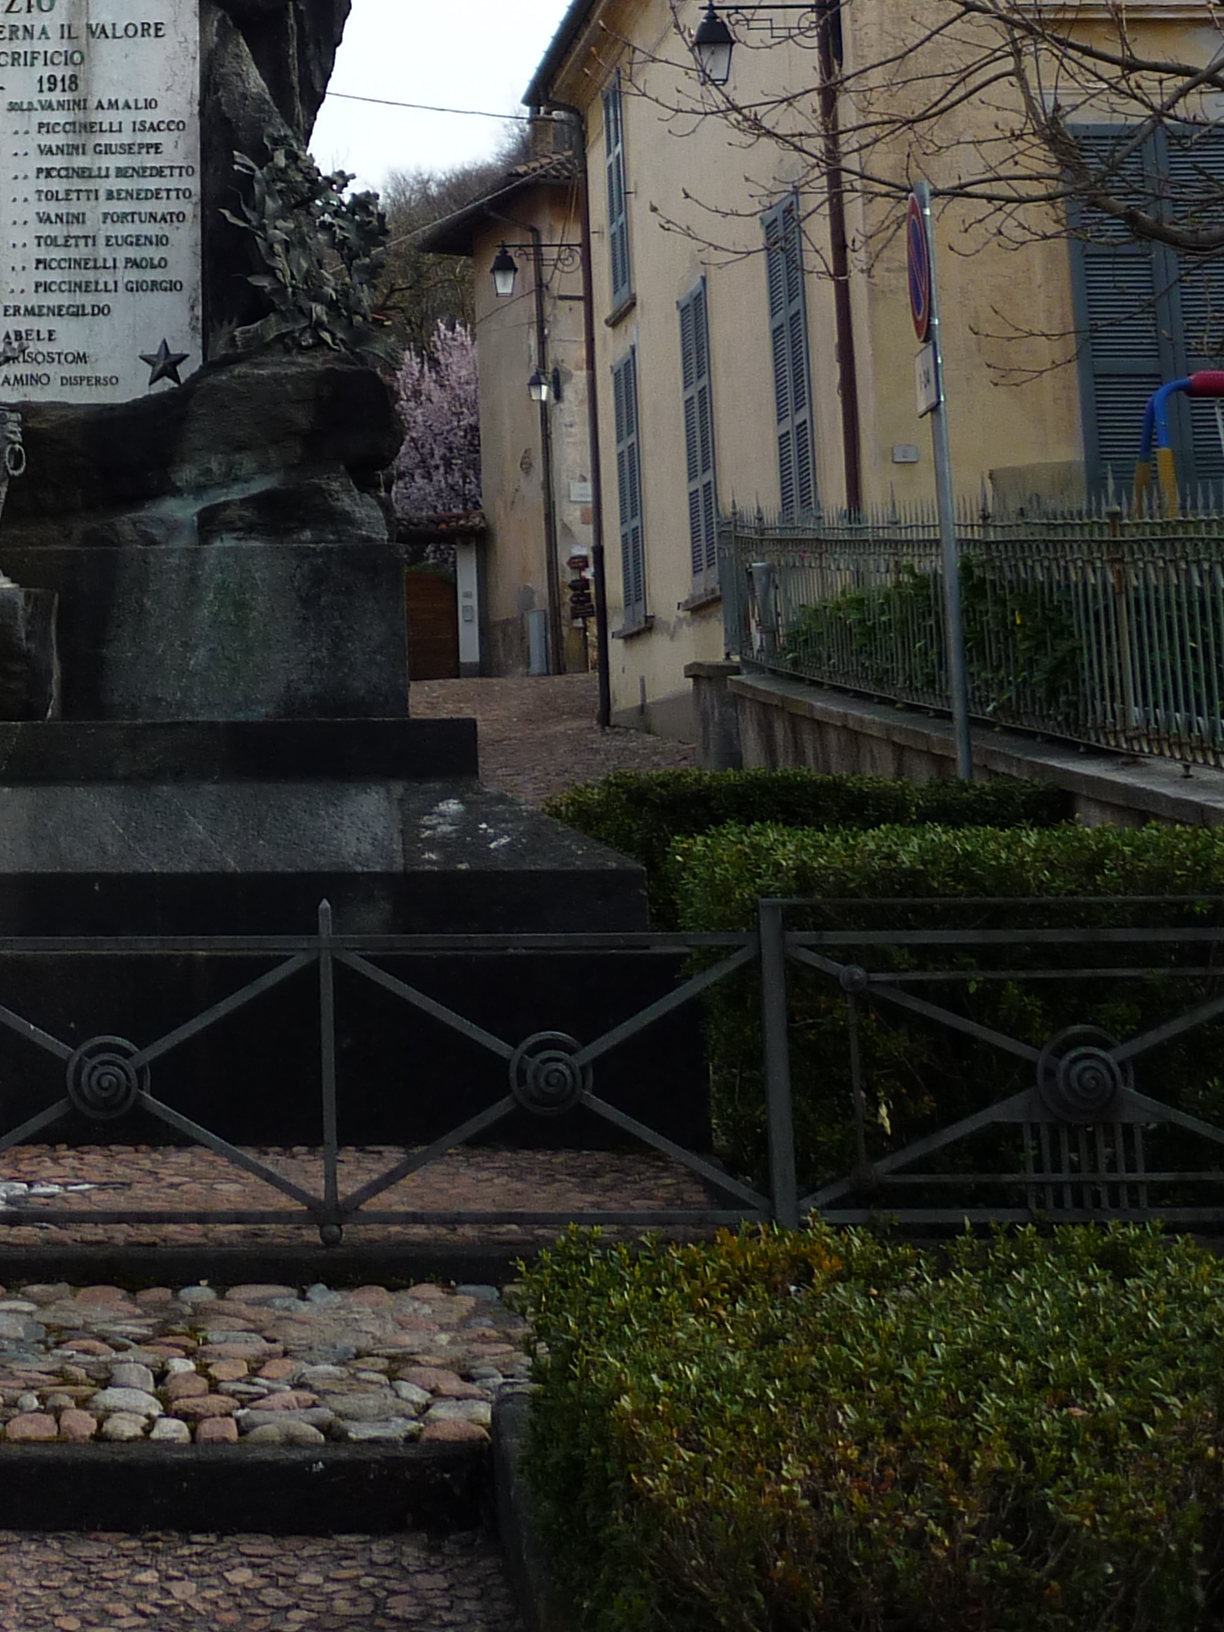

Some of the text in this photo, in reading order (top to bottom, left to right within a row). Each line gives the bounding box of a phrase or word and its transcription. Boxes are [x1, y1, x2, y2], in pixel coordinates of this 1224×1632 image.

[60, 23, 78, 40] IL
[87, 22, 166, 39] VALORE
[37, 74, 79, 93] 1918
[37, 98, 88, 111] VANINI
[94, 98, 158, 110] AMALIO
[37, 120, 186, 134] PICCINELLI ISACCO
[37, 143, 163, 156] VANINI GIUSEPPE
[35, 165, 194, 179] PICCINELLI BENEDETTO
[34, 188, 192, 202] TOLETTI BENEDETTO
[35, 211, 186, 225] VANINI FORTUNATO
[34, 234, 169, 248] TOLETTI EUGENIO
[34, 257, 168, 271] PICCINELLI PAOLO
[34, 280, 184, 293] PICCINELLI GIORGIO
[3, 304, 111, 317] ERMENEGILDO
[2, 329, 56, 342] ABELE
[60, 375, 119, 387] DISPERSO
